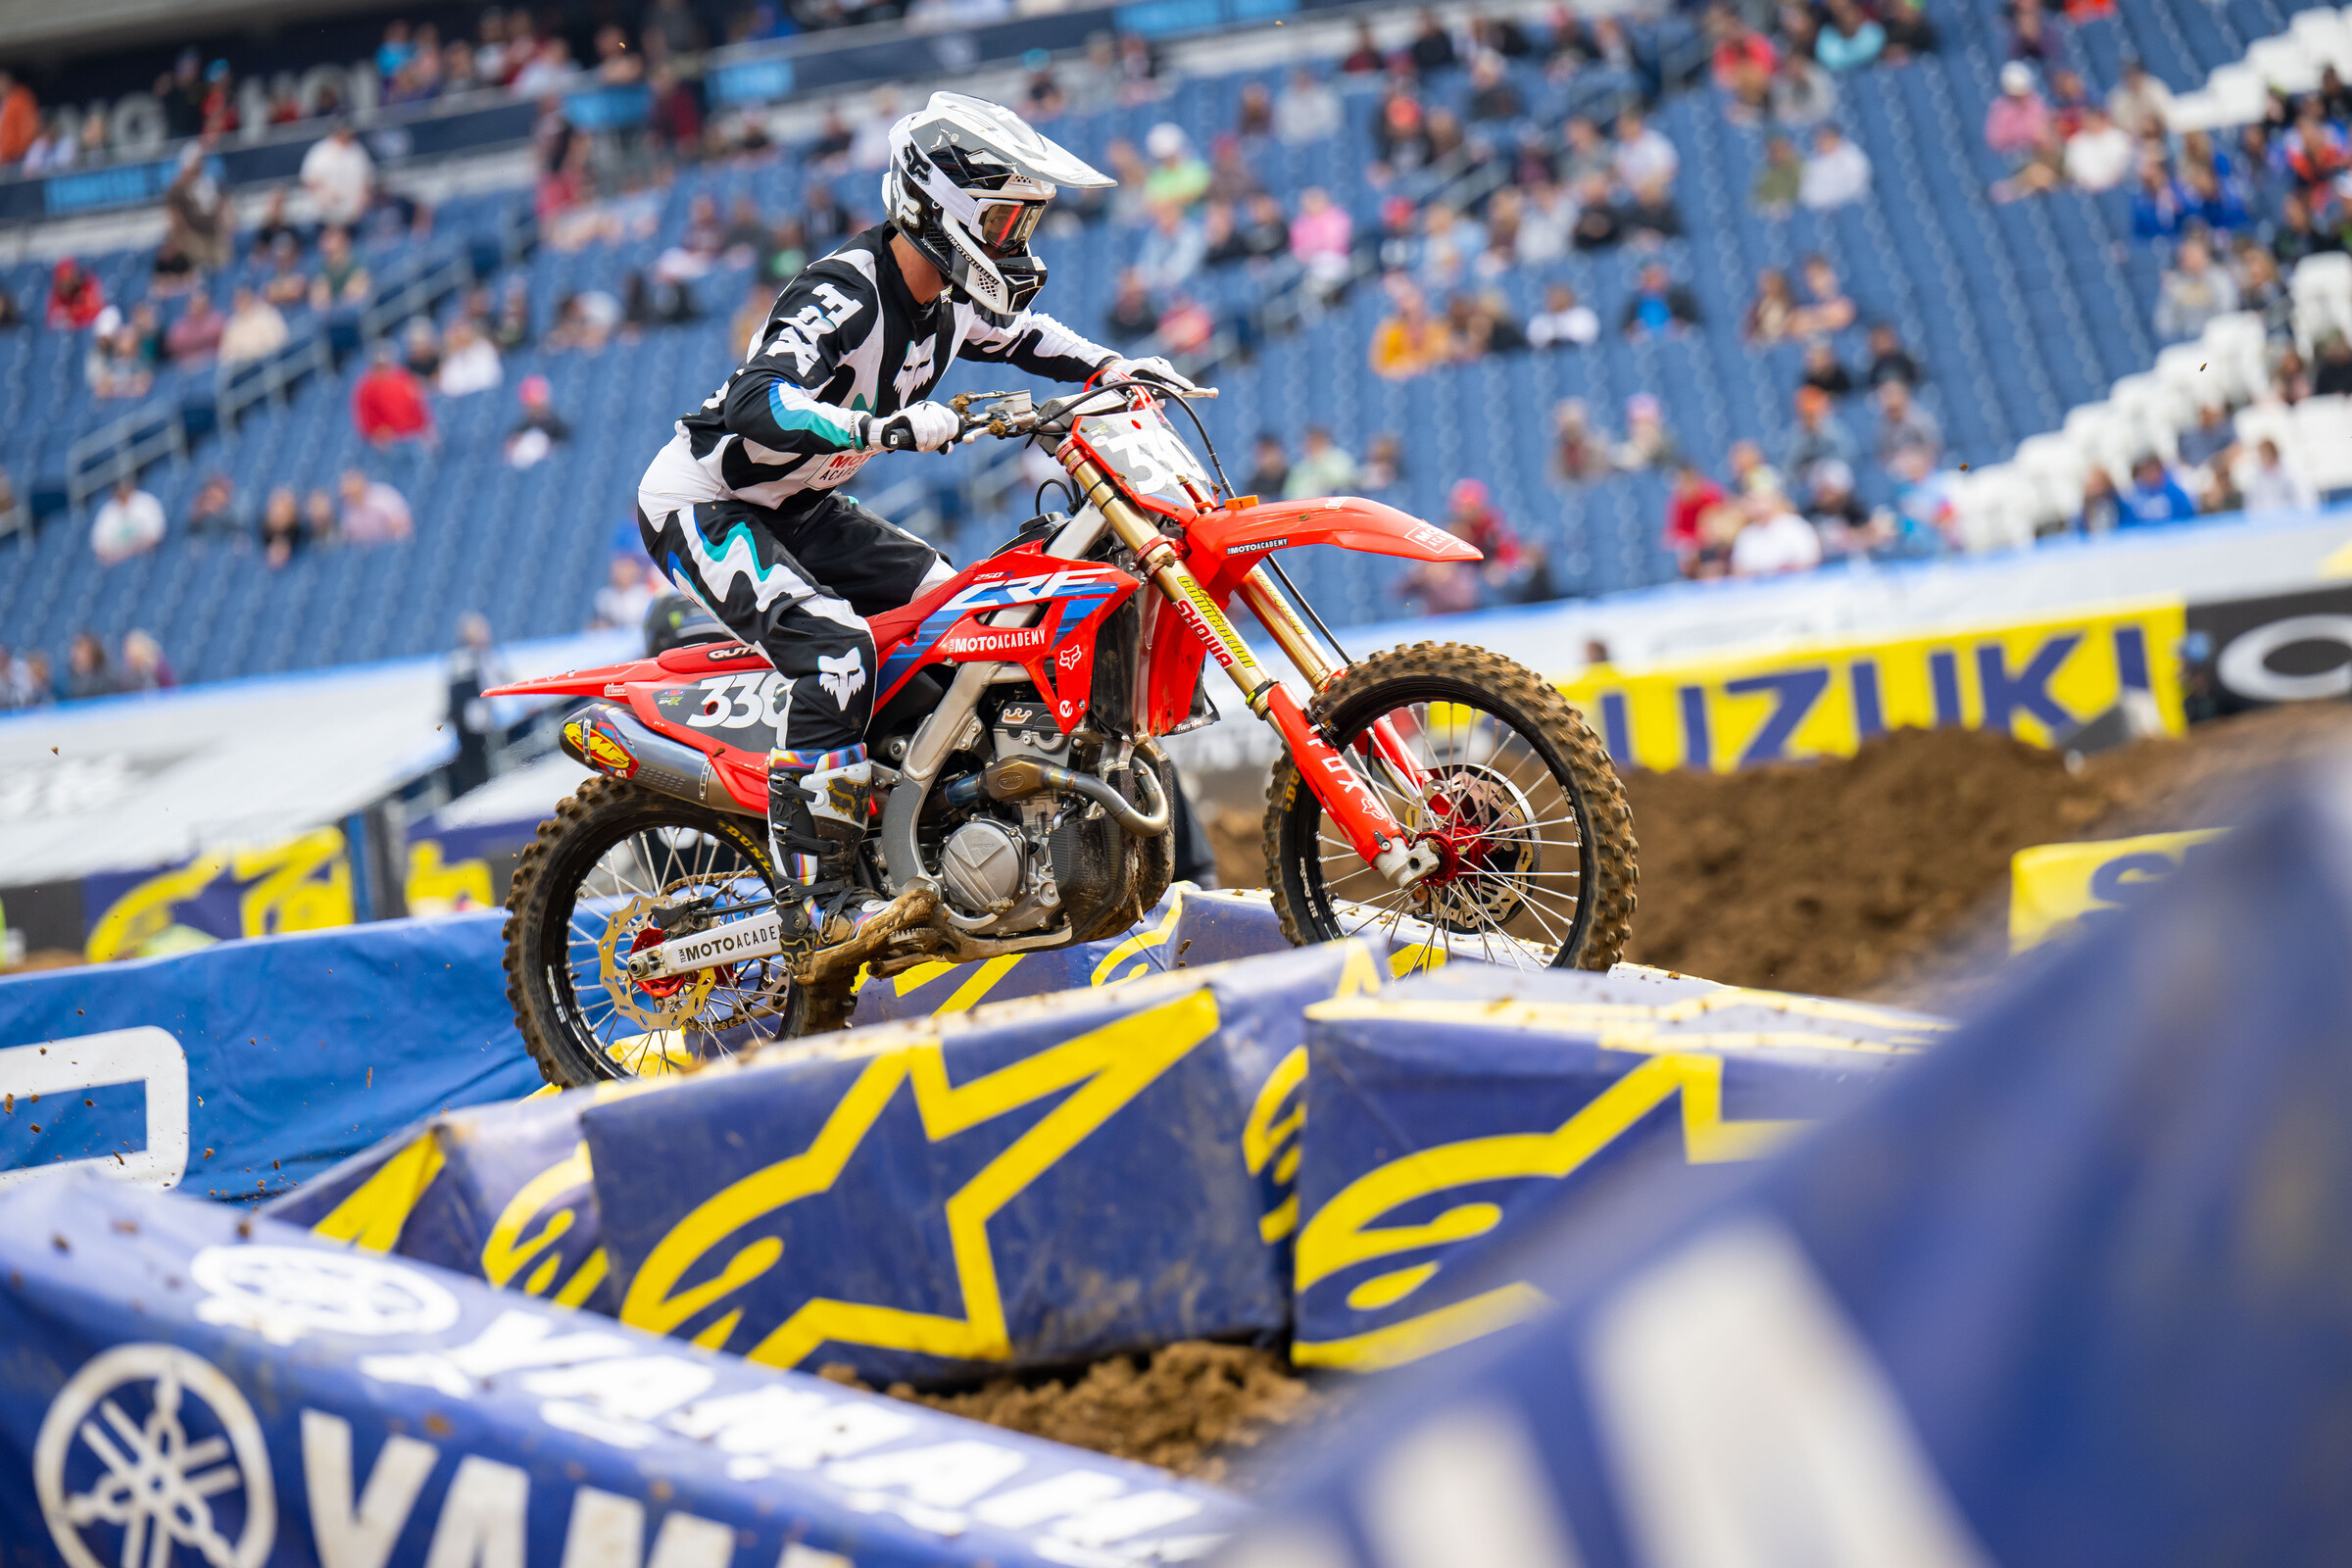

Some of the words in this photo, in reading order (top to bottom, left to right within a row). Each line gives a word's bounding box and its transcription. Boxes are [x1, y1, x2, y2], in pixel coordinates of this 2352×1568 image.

[938, 567, 1117, 612] CRF
[1174, 598, 1235, 669] SHOWA
[1599, 625, 2151, 770] UZUKI
